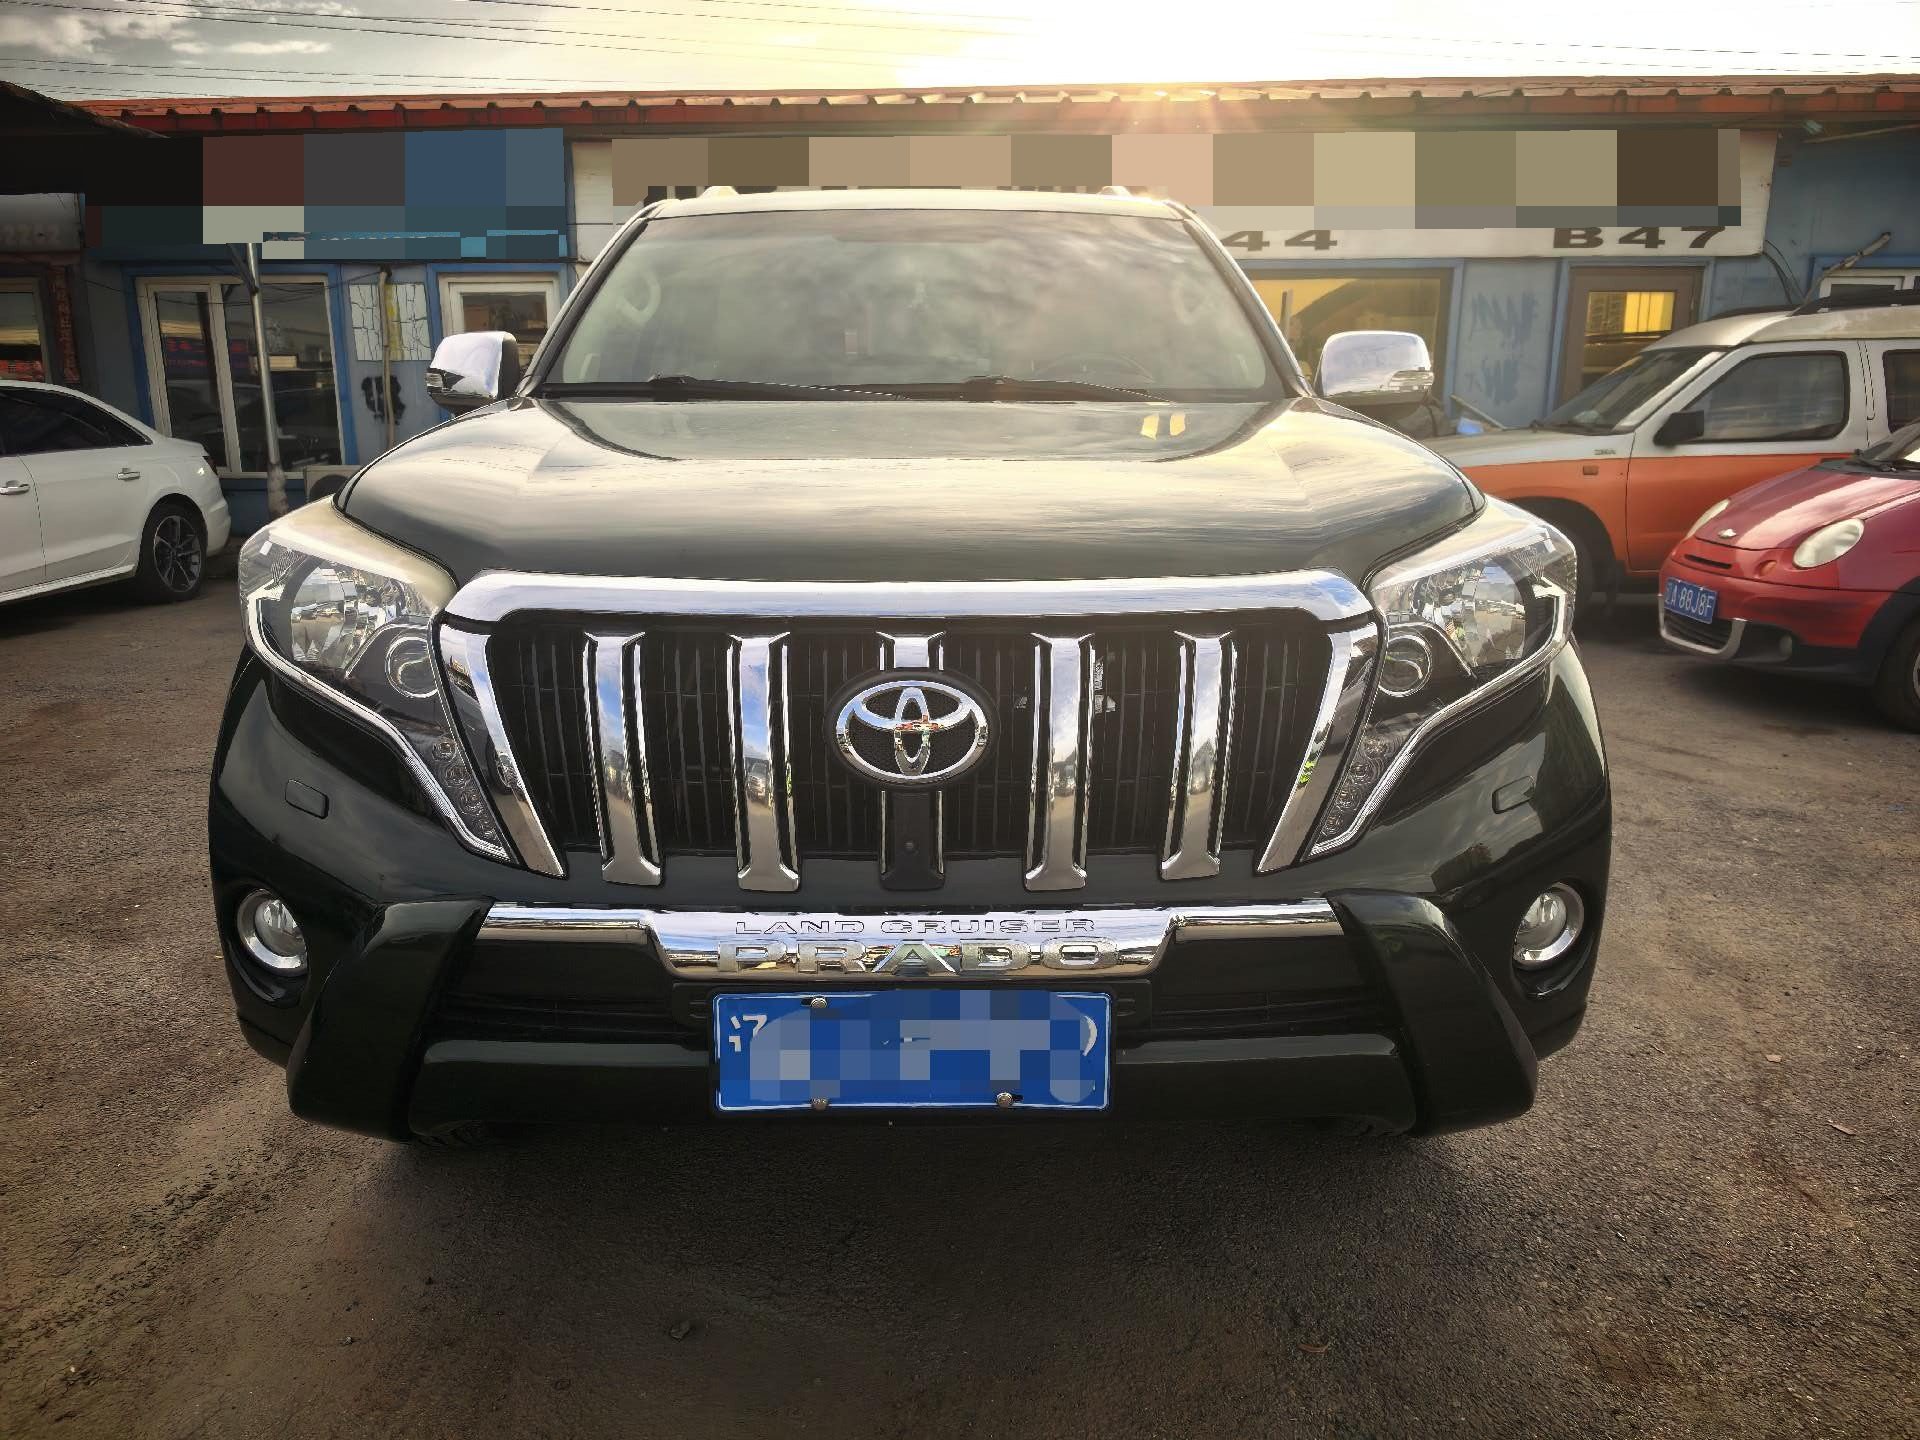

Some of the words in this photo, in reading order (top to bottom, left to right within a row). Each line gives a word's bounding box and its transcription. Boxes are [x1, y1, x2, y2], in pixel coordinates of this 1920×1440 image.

[1553, 226, 1726, 249] B47
[735, 920, 865, 935] LAND
[881, 919, 1094, 934] CRUISER
[717, 935, 1118, 975] PRADO
